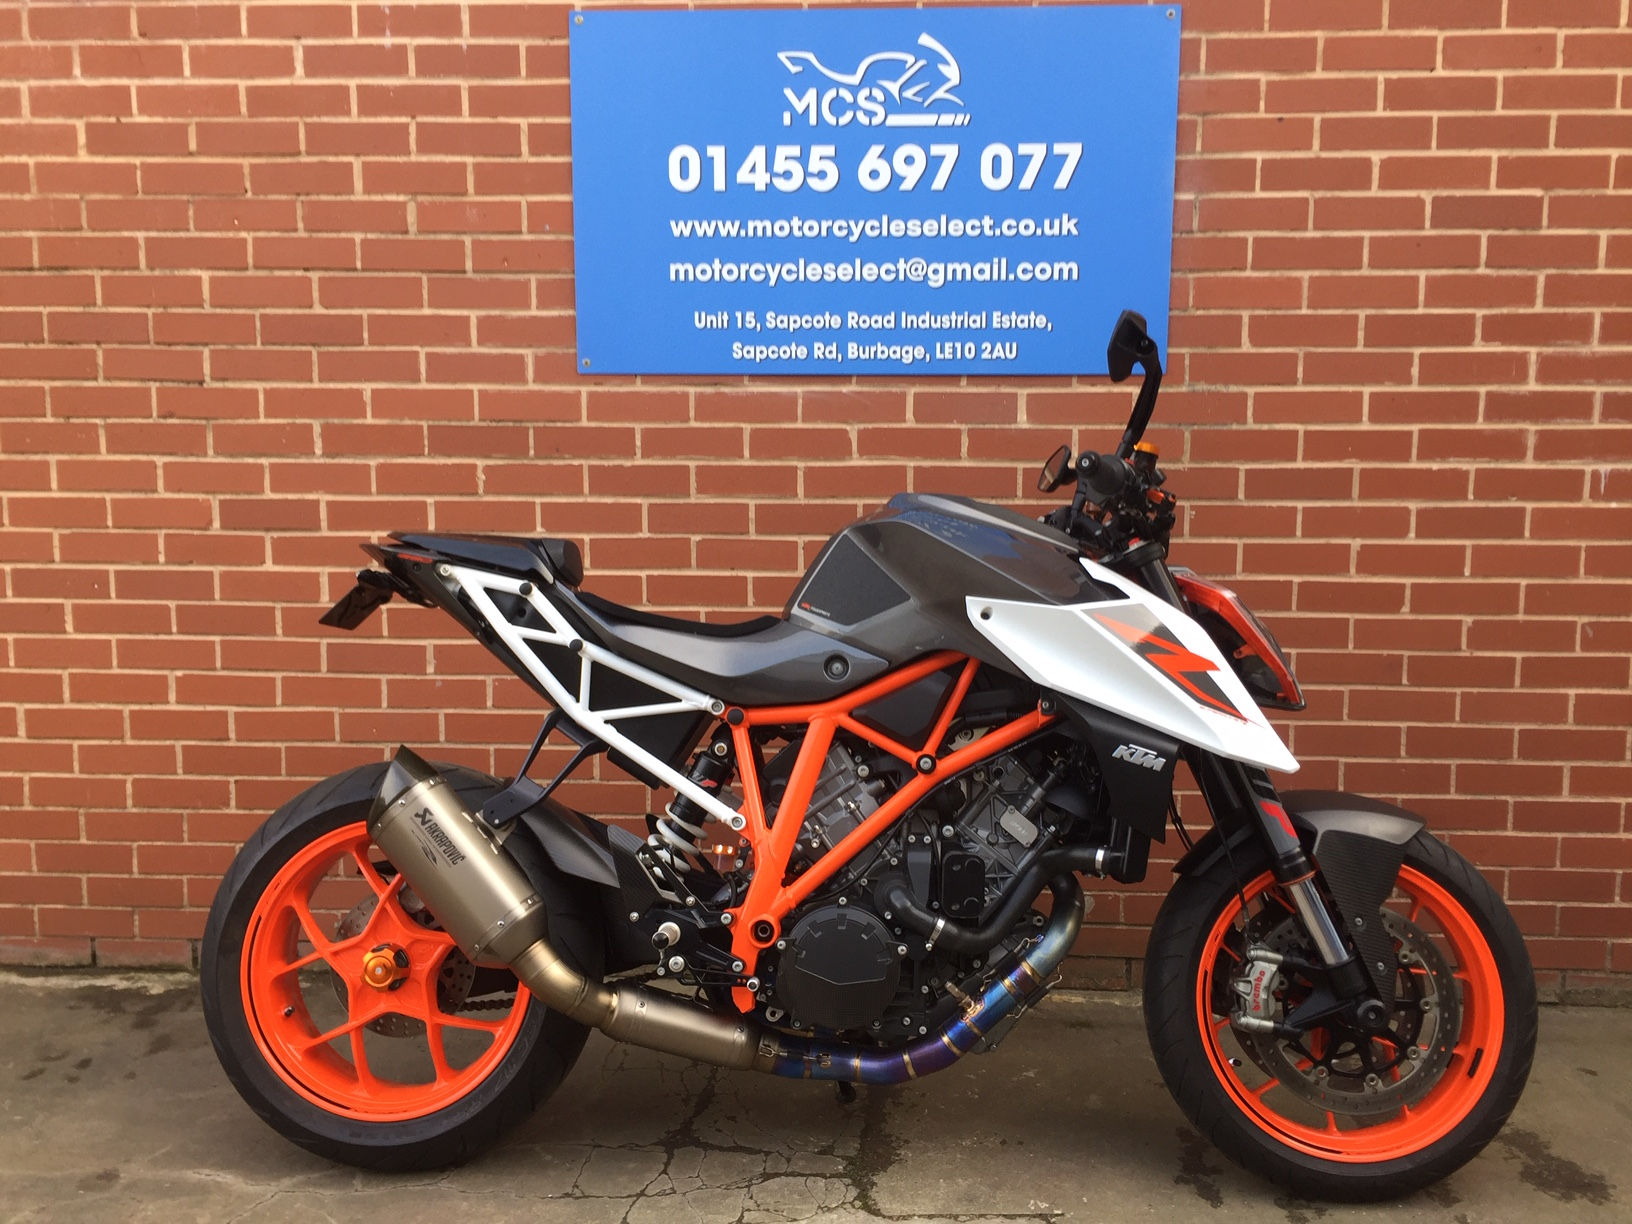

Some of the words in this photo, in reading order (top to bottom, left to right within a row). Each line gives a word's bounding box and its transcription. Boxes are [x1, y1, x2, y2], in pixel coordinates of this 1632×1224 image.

[783, 87, 886, 126] MCS
[668, 144, 840, 192] 01455
[858, 143, 960, 192] 697
[980, 142, 1083, 191] 077
[670, 213, 1079, 242] www.motorcycleselect.co.uk
[669, 257, 1080, 288] motorcycleselect@gmail.com
[694, 311, 729, 329] Unit
[734, 311, 761, 332] 15,
[766, 311, 842, 332] Sapcote
[848, 311, 895, 329] Road
[901, 311, 987, 329] Industrial
[992, 311, 1053, 332] Estate,
[732, 342, 808, 363] Sapcote
[814, 342, 842, 363] Rd,
[848, 342, 931, 364] Burbage,
[936, 342, 976, 360] LE10
[981, 341, 1018, 360] 2AU
[1112, 744, 1166, 772] KTM
[1252, 970, 1266, 1012] brembo
